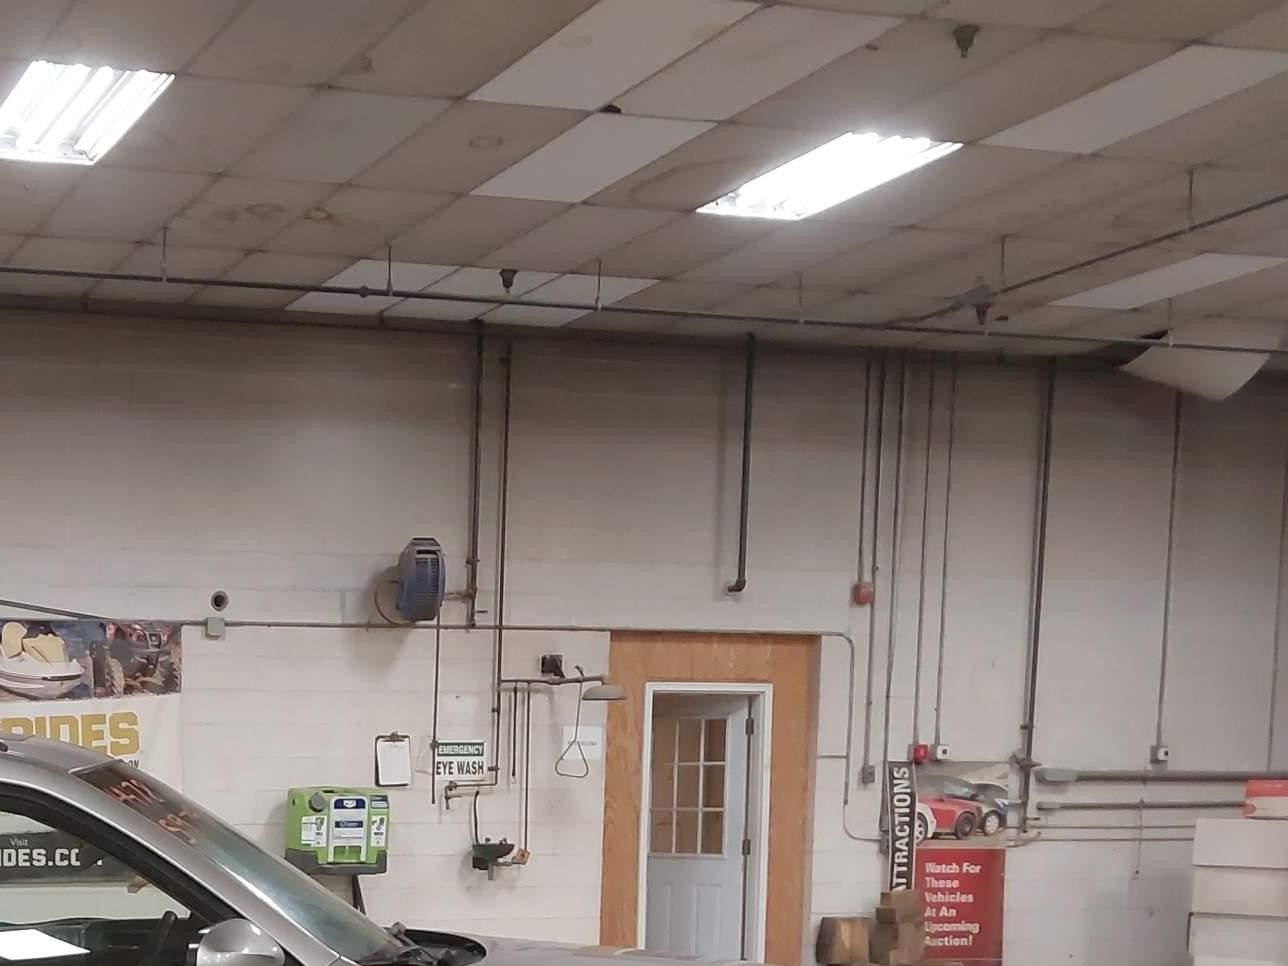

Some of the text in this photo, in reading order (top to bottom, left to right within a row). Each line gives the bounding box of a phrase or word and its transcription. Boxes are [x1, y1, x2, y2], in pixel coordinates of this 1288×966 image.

[438, 744, 483, 755] EMERGENCY
[436, 761, 485, 776] EYE WASH
[9, 837, 29, 847] Visit
[924, 862, 982, 873] Watch For
[924, 877, 960, 888] These
[924, 891, 974, 903] Vehicles
[924, 906, 957, 917] At An
[924, 920, 980, 934] Upcoming
